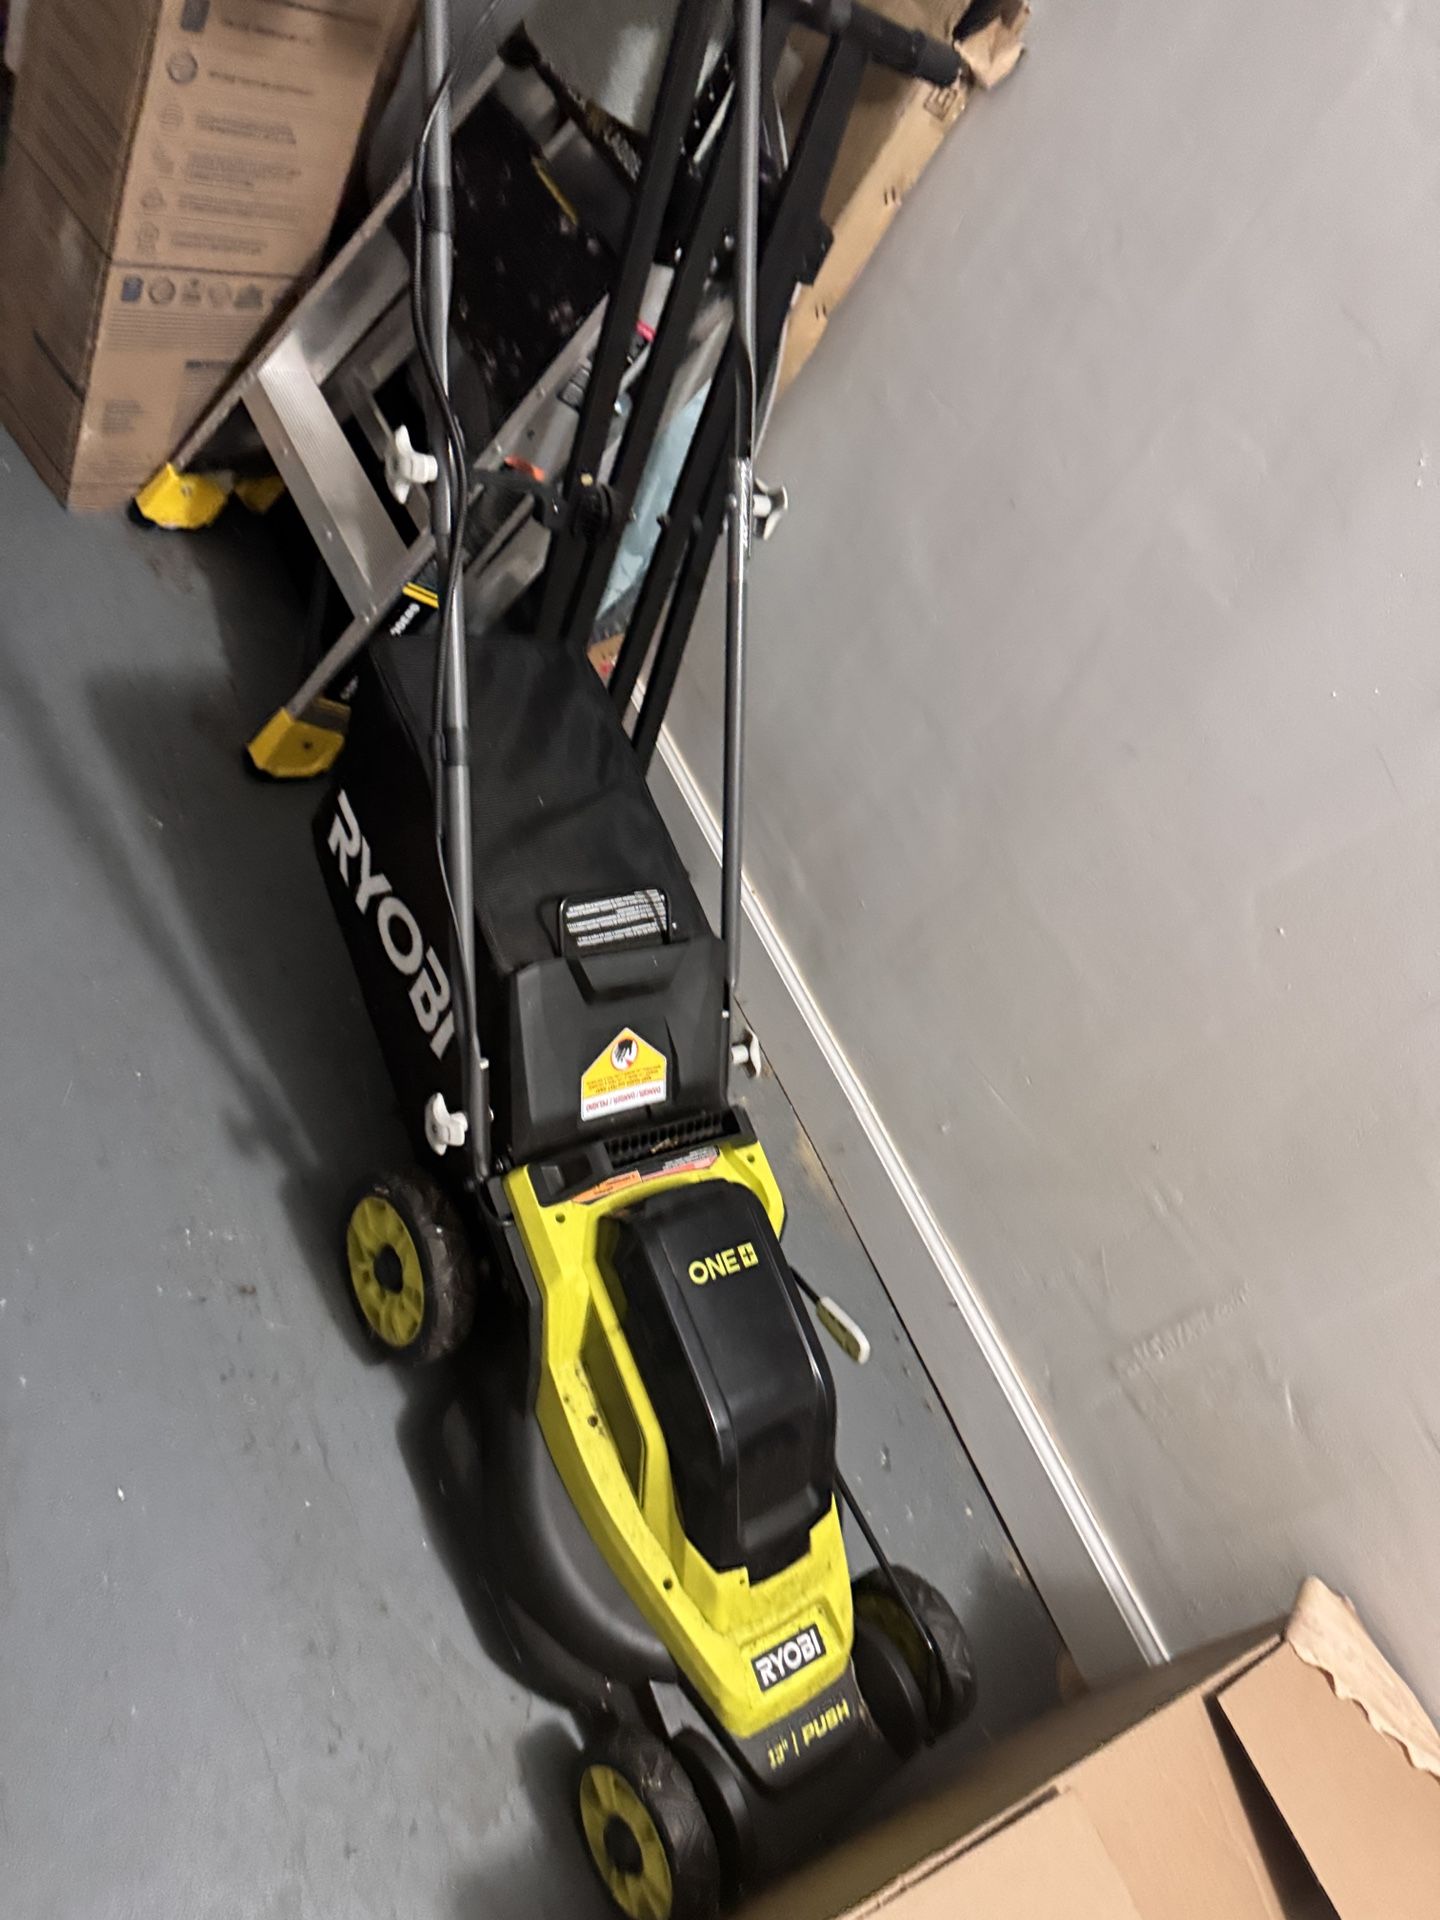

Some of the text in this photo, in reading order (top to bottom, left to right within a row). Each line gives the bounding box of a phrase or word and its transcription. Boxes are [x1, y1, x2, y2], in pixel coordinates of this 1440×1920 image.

[327, 788, 455, 1061] RYOBI
[755, 1628, 822, 1687] RYOBI
[802, 1698, 850, 1747] PUSH
